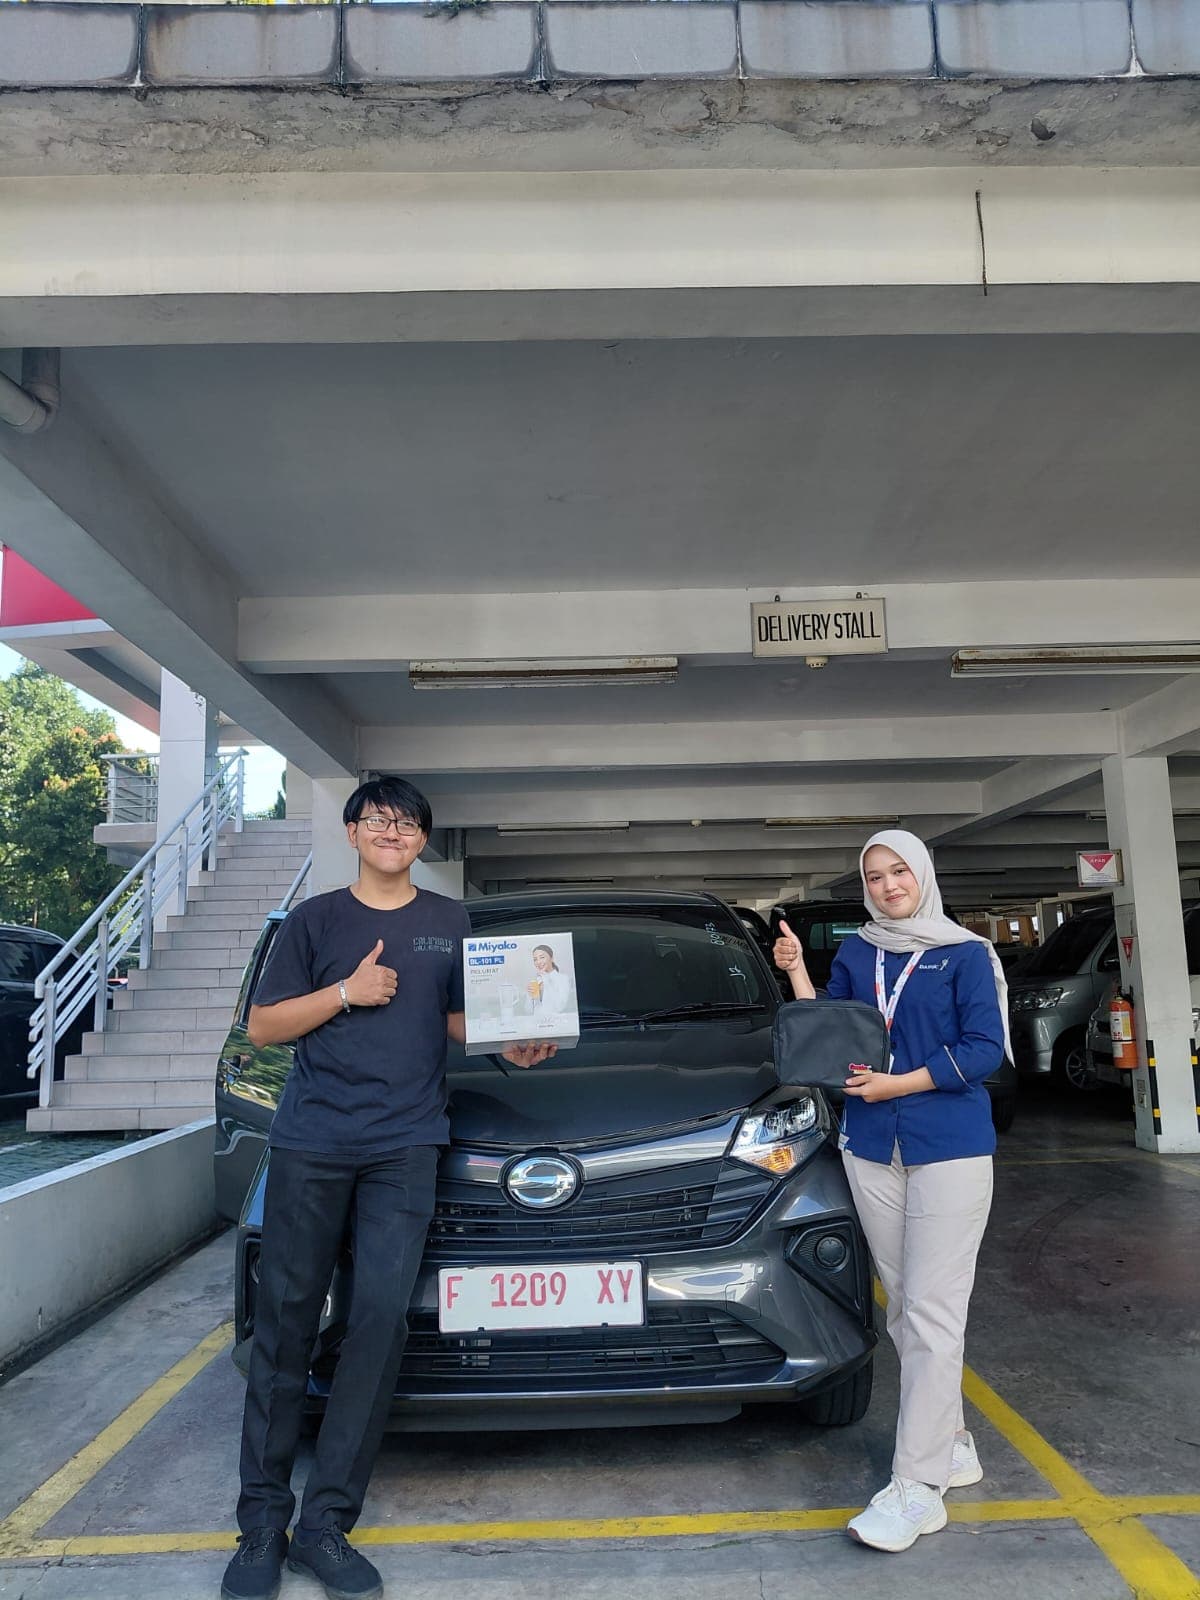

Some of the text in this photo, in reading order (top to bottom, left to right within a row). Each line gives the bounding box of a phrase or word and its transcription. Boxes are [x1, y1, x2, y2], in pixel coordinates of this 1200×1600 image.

[758, 611, 881, 642] DELIVERY STALL
[478, 940, 517, 952] Miyako
[447, 1269, 633, 1309] F 1209 XY
